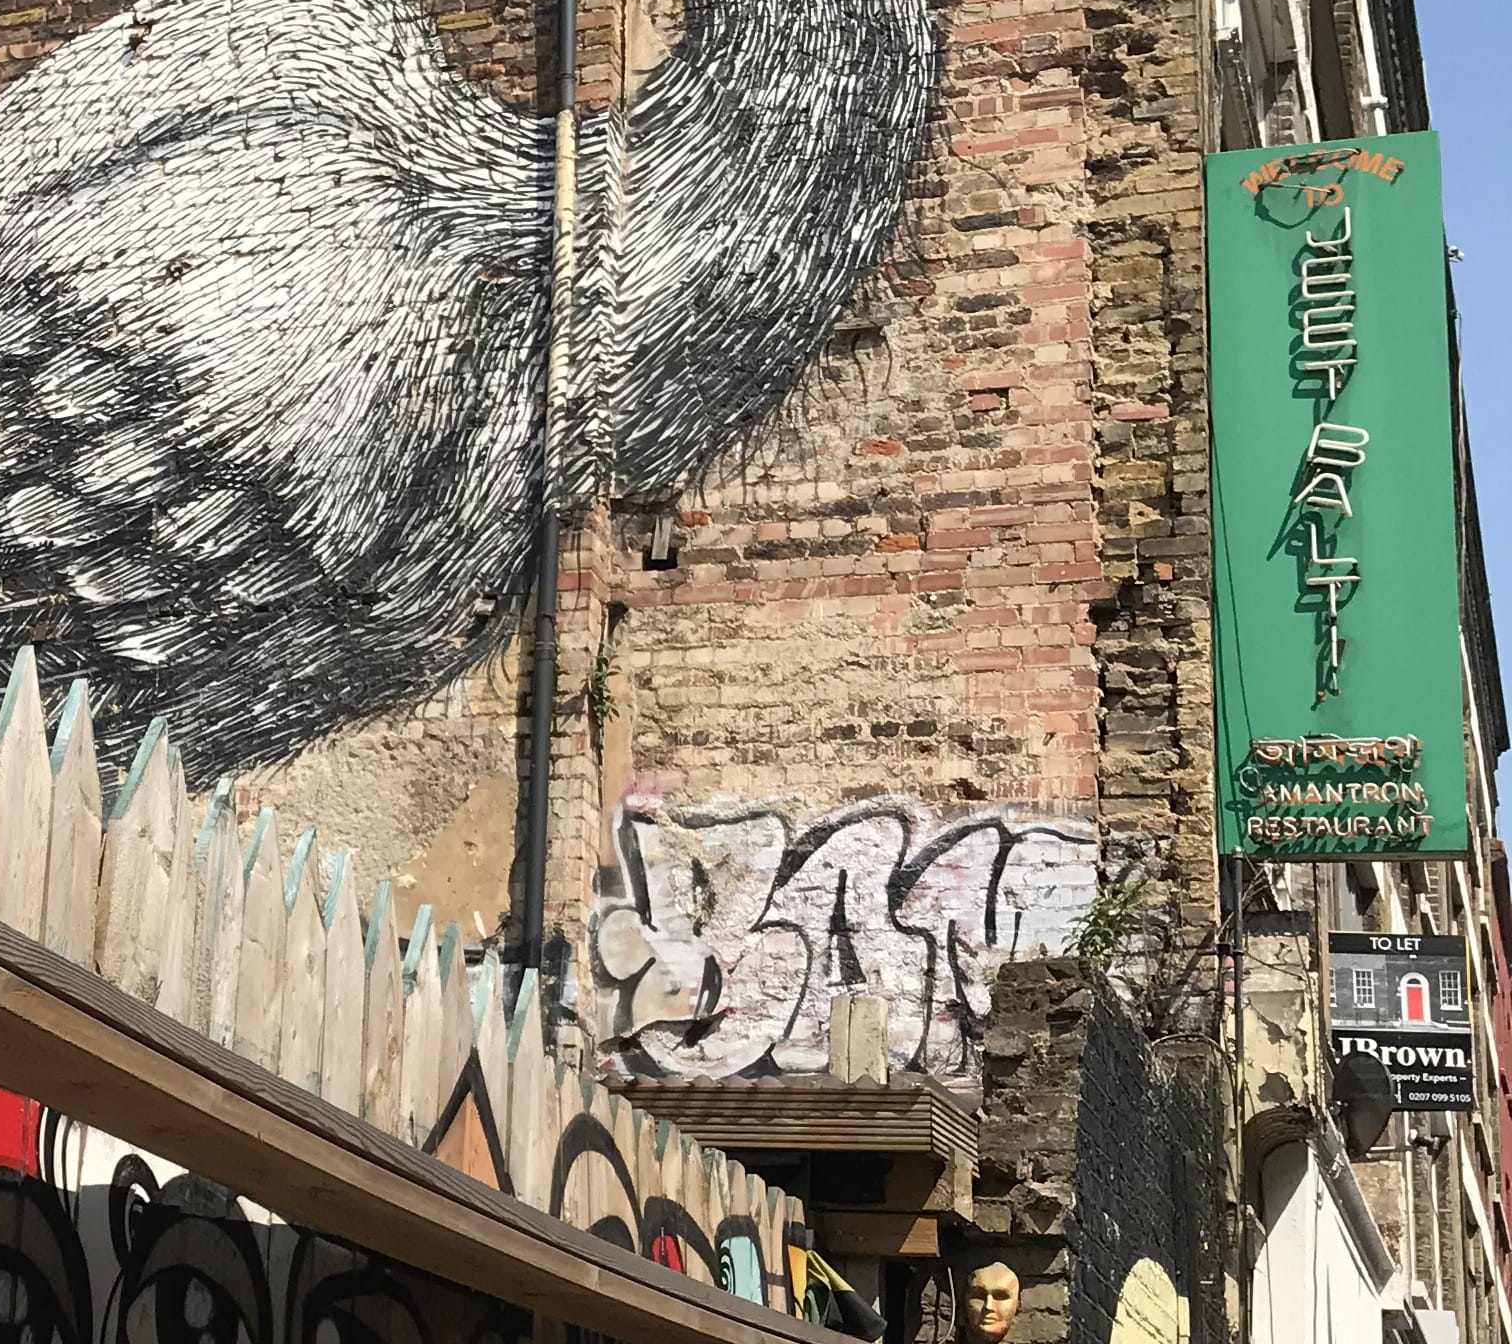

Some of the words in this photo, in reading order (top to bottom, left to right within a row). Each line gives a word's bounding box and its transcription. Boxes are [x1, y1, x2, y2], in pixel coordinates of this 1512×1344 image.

[1240, 149, 1405, 194] WELCOME
[1304, 183, 1345, 208] TO
[1261, 782, 1425, 806] AMANTRON
[1248, 815, 1434, 838] RESTAURANT
[1369, 936, 1392, 951] TO
[1396, 937, 1422, 951] LET
[1423, 1073, 1458, 1084] Experts
[1408, 1092, 1430, 1102] 0207
